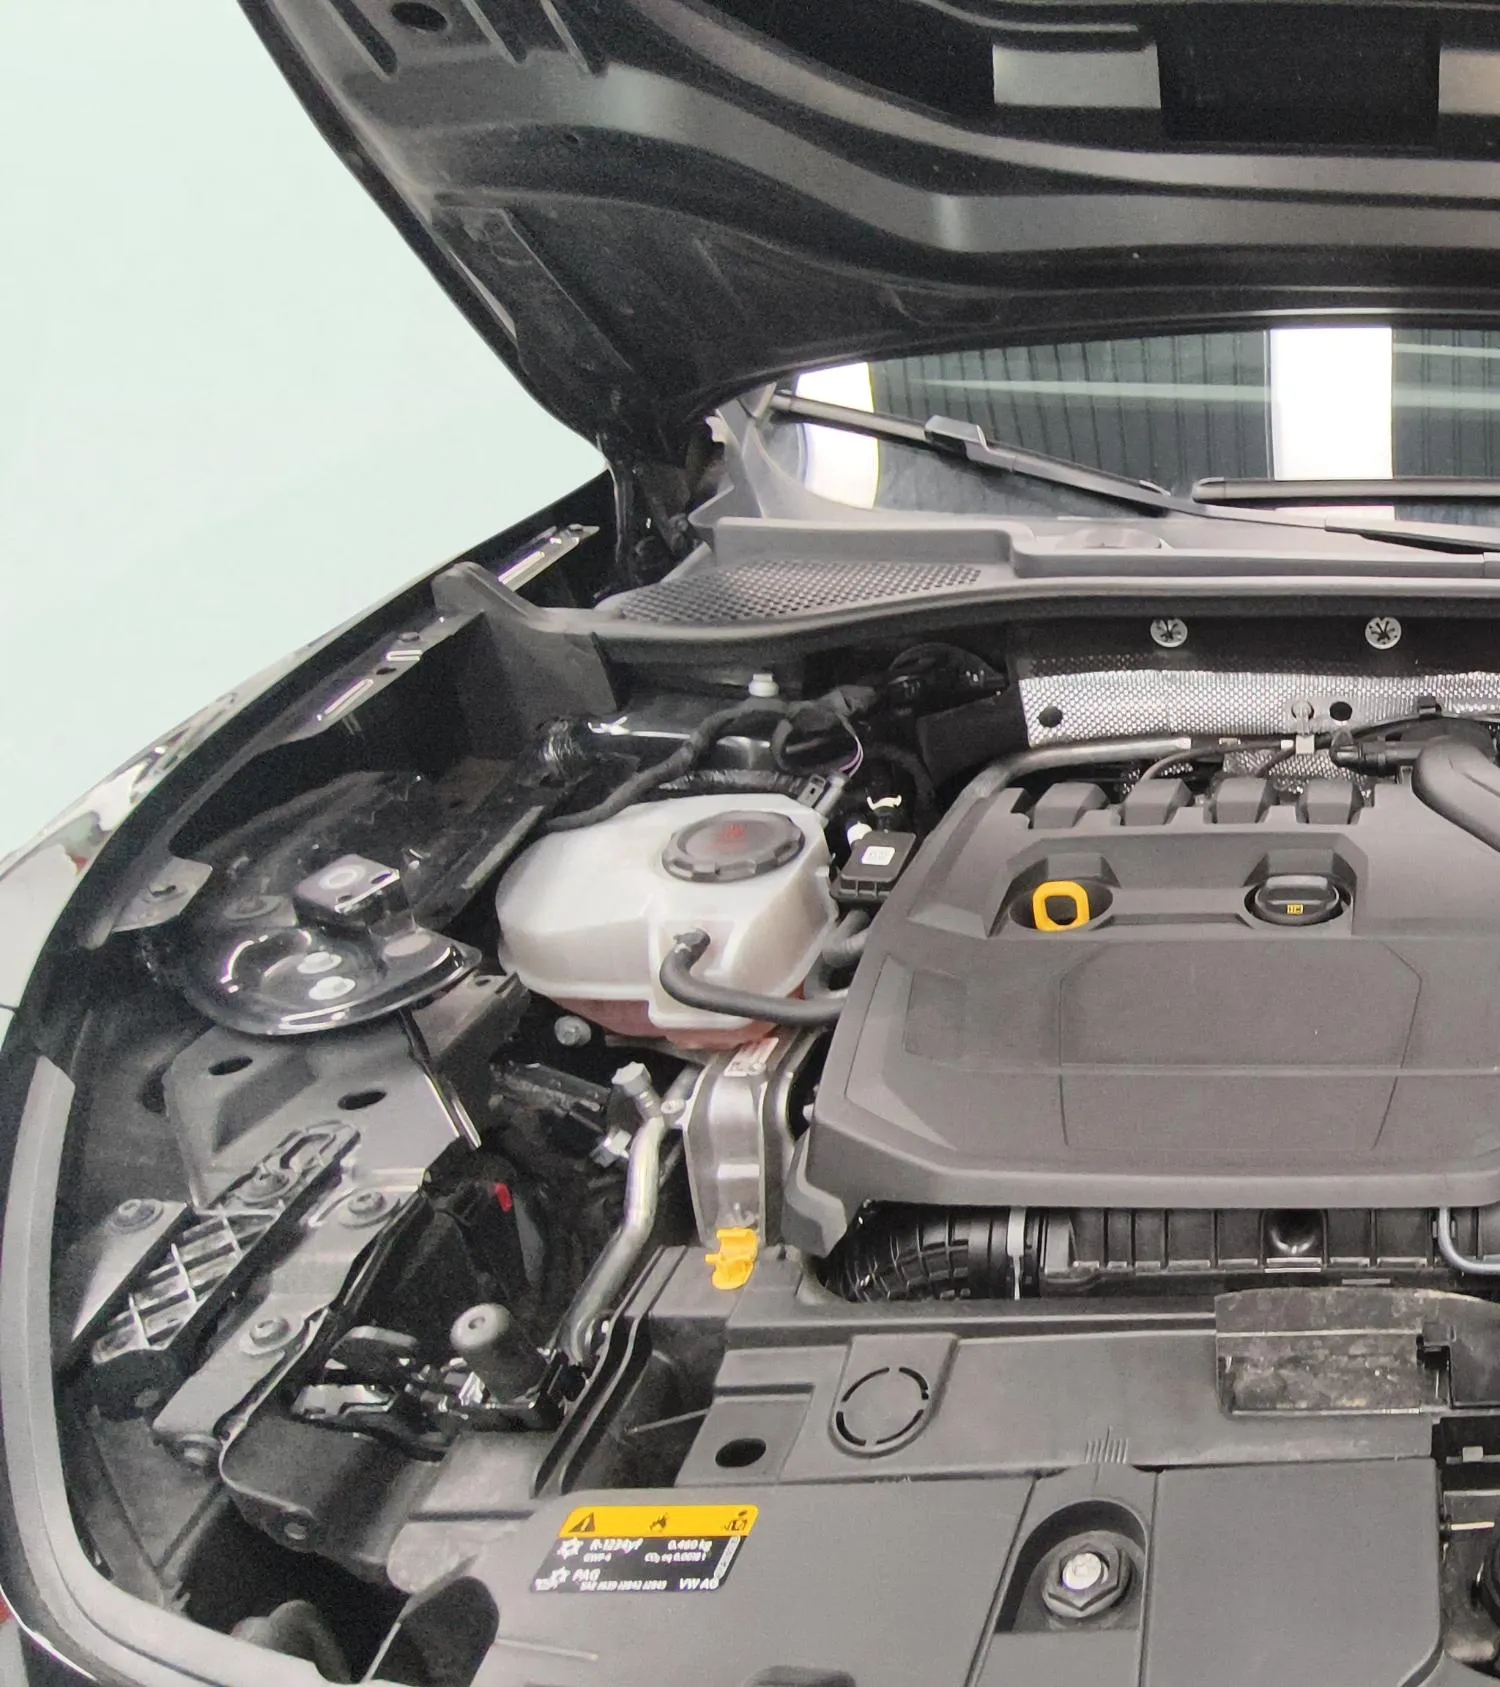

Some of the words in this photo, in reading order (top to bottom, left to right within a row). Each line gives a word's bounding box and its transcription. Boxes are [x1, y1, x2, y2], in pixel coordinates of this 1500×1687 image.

[698, 1540, 713, 1553] kg
[679, 1578, 701, 1590] VW
[700, 1578, 721, 1590] AG
